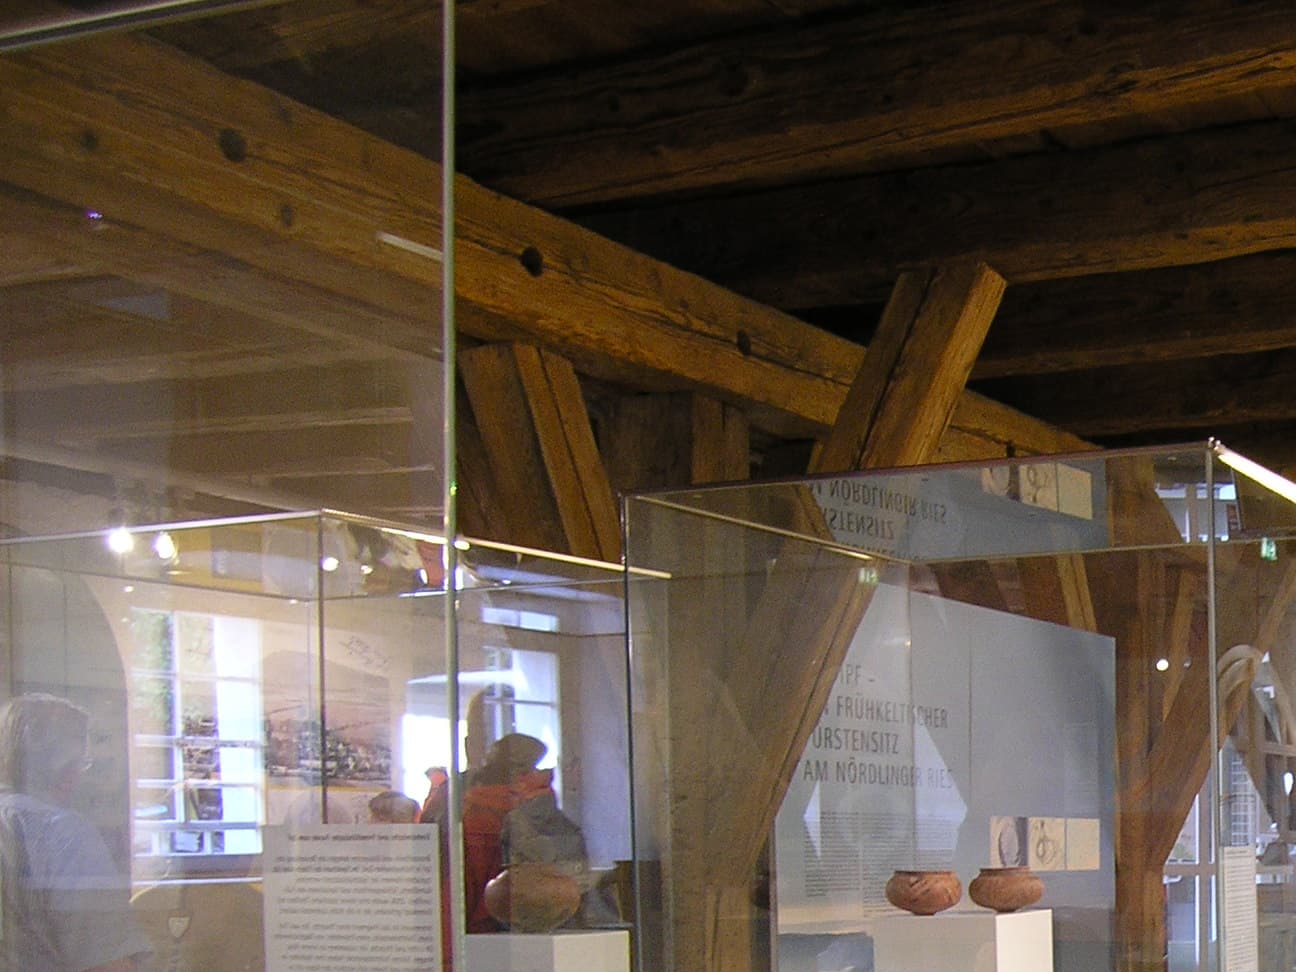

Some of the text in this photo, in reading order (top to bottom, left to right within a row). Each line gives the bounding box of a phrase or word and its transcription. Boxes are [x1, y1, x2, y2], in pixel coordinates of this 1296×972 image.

[836, 692, 949, 729] FRÜHKELTISCHER
[803, 759, 829, 782] AM
[835, 756, 923, 788] NÖRDLINGER
